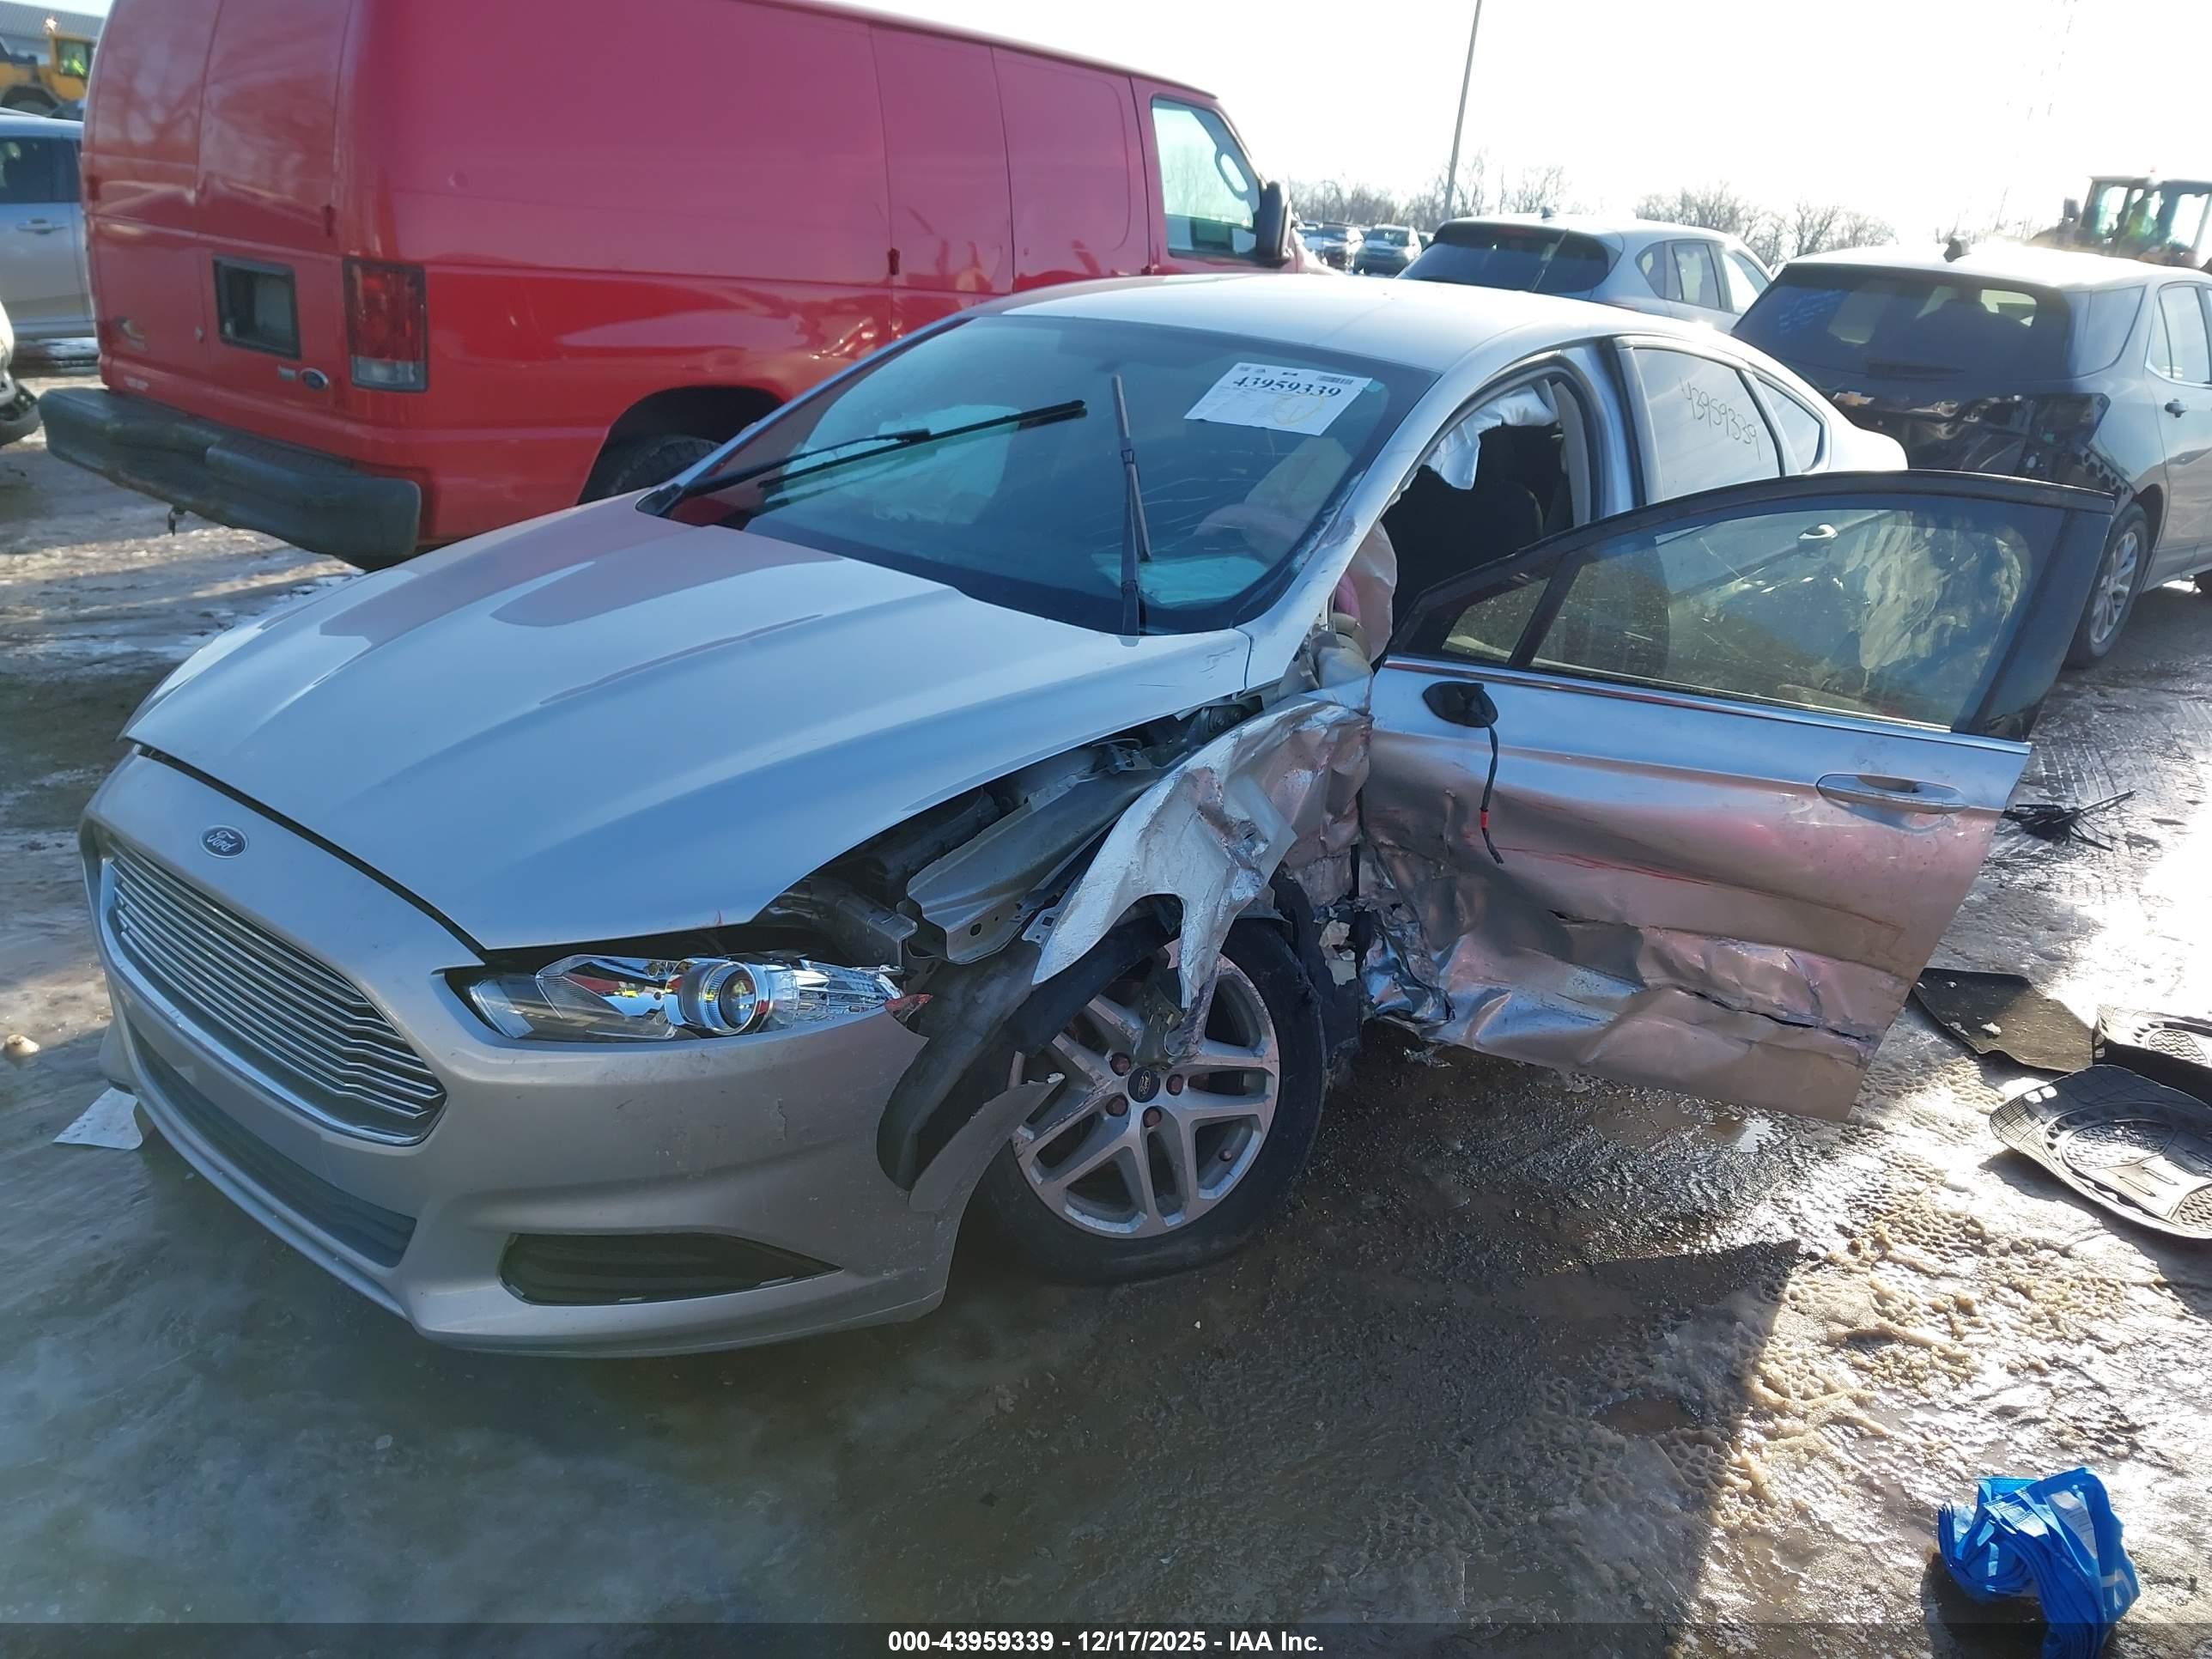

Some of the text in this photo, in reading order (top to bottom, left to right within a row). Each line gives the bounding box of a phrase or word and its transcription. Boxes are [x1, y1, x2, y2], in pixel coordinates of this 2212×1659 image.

[1233, 375, 1342, 398] 43959339
[1679, 377, 1761, 461] 43959339
[207, 830, 238, 853] Ford
